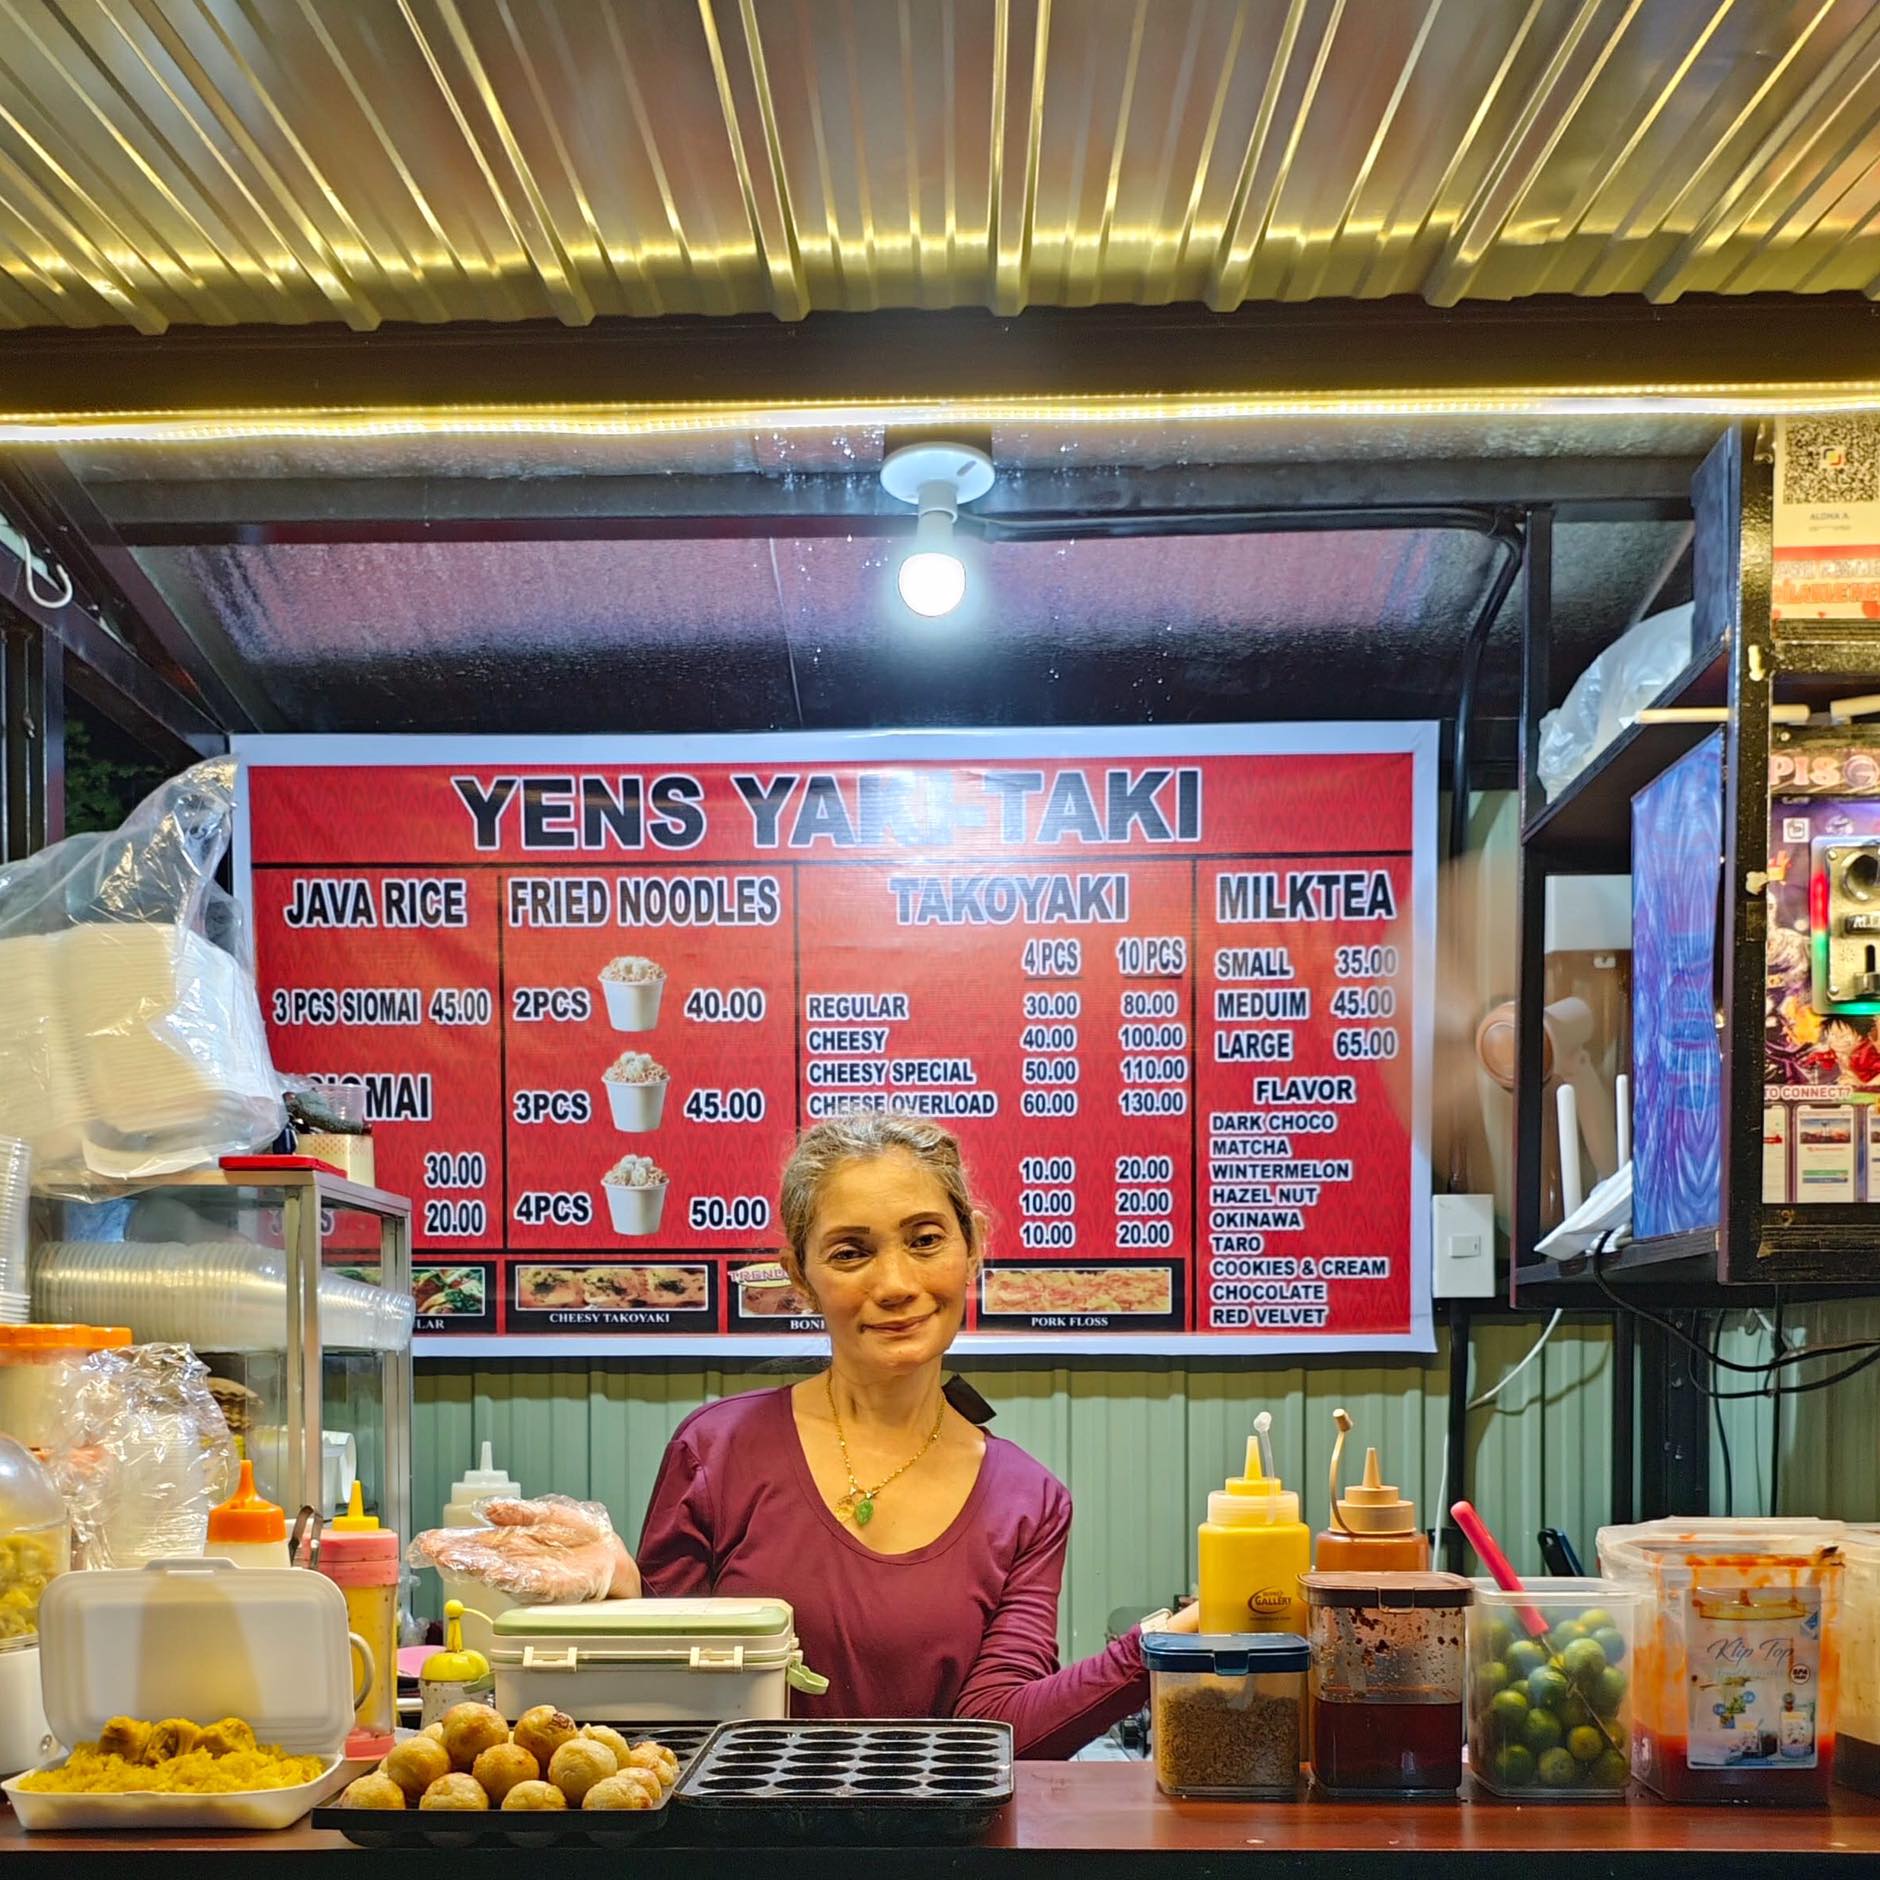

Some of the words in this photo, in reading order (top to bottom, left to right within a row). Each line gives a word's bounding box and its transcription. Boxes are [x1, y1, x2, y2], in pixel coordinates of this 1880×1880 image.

[452, 775, 705, 850] YENS
[731, 767, 1203, 849] YAKI-TAKI
[285, 879, 376, 928] JAVA
[382, 878, 467, 927] RICE
[509, 878, 609, 926] FRIED
[619, 877, 779, 926] NOODLES
[889, 874, 1129, 925] TAKOYAKI
[1217, 870, 1396, 923] MILKTEA
[1117, 938, 1143, 974] 10
[1146, 937, 1185, 973] PCS
[1216, 948, 1293, 978] SMALL
[1337, 946, 1398, 978] 35.00
[342, 989, 421, 1024] SIOMAI
[430, 988, 491, 1024] 45.00
[514, 987, 591, 1020] 2PCS
[685, 988, 766, 1021] 40.00
[807, 994, 908, 1020] REGULAR
[1024, 992, 1081, 1019] 30.00
[1121, 992, 1178, 1018] 80.00
[1216, 988, 1309, 1019] MEDUIM
[1332, 987, 1396, 1019] 45.00
[808, 1027, 889, 1055] CHEESY
[1021, 1025, 1077, 1051] 40.00
[1119, 1024, 1186, 1051] 100.00
[1215, 1030, 1293, 1062] LARGE
[1334, 1028, 1398, 1061] 65.00
[808, 1061, 888, 1086] CHEESY
[891, 1059, 976, 1084] SPECIAL
[1023, 1058, 1079, 1084] 50.00
[1121, 1056, 1187, 1083] 110.00
[307, 1073, 433, 1121] MAI
[808, 1092, 886, 1116] CHEESE
[891, 1092, 997, 1117] OVERLOAD
[1021, 1090, 1079, 1117] 60.00
[1119, 1089, 1187, 1116] 130.00
[1254, 1077, 1357, 1105] FLAVOR
[1782, 1085, 1852, 1099] CONNECT?
[514, 1089, 591, 1124] 3PCS
[684, 1088, 765, 1122] 45.00
[1210, 1113, 1264, 1132] DARK
[1267, 1112, 1337, 1132] CHOCO
[1210, 1137, 1291, 1157] MATCHA
[424, 1152, 486, 1188] 30.00
[1019, 1157, 1075, 1182] 10.00
[1115, 1156, 1173, 1181] 20.00
[1210, 1160, 1352, 1182] WINTERMELON
[1019, 1190, 1075, 1215] 10.00
[1115, 1189, 1173, 1215] 20.00
[1210, 1186, 1274, 1206] HAZEL
[1277, 1185, 1319, 1205] NUT
[424, 1199, 487, 1236] 20.00
[514, 1192, 592, 1225] 4PCS
[689, 1196, 769, 1231] 50.00
[1210, 1209, 1304, 1231] OKINAWA
[1019, 1222, 1076, 1247] 10.00
[1115, 1221, 1173, 1247] 20.00
[1210, 1234, 1263, 1254] TARO
[728, 1268, 788, 1282] TREND
[1210, 1258, 1296, 1278] COOKIES
[1300, 1259, 1316, 1277] &
[1319, 1257, 1389, 1277] CREAM
[1210, 1282, 1327, 1302] CHOCOLATE
[549, 1313, 601, 1324] CHEESY
[603, 1313, 670, 1323] TAKOYAKI
[790, 1319, 825, 1330] BONI
[1031, 1317, 1067, 1327] PORK
[1070, 1316, 1109, 1327] FLOSS
[1210, 1306, 1250, 1327] RED
[1253, 1305, 1328, 1326] VELVET
[1759, 1637, 1794, 1668] Top
